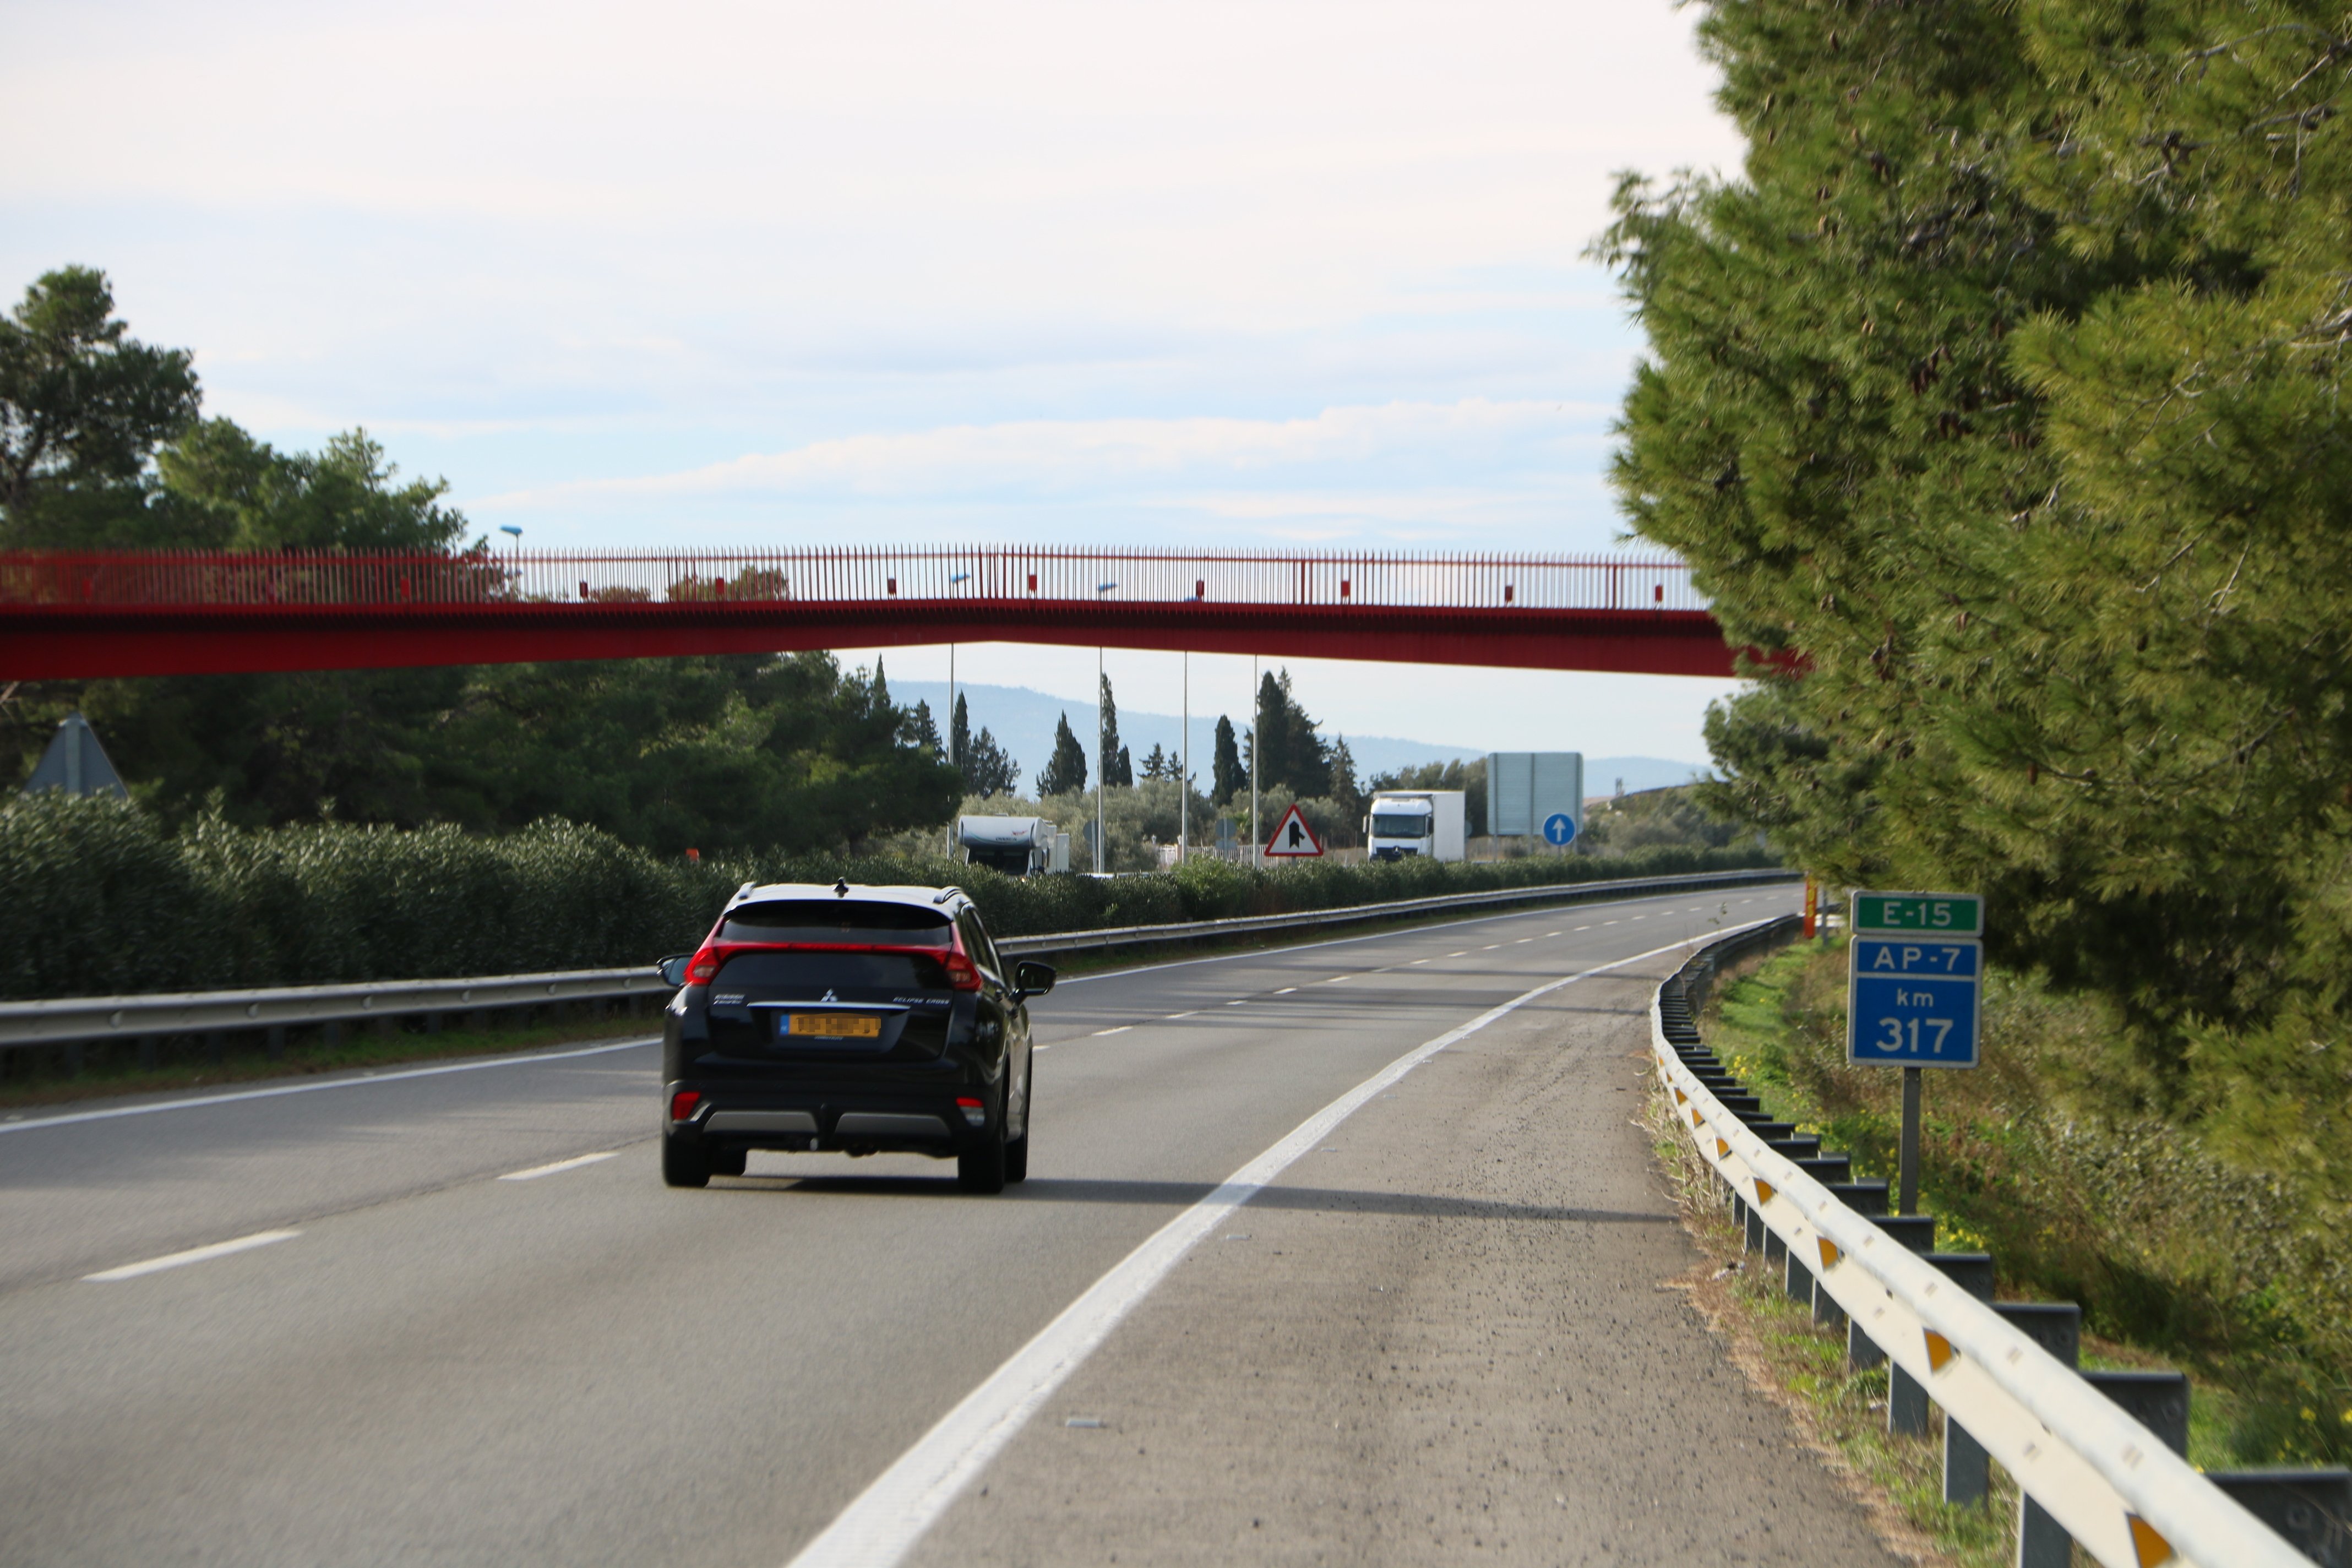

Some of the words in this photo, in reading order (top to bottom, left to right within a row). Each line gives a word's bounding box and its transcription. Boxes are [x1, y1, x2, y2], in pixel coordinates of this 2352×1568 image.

[1883, 901, 1951, 926] E-15
[1873, 946, 1961, 971] AP-7
[1897, 988, 1934, 1008] km
[1876, 1017, 1954, 1054] 317
